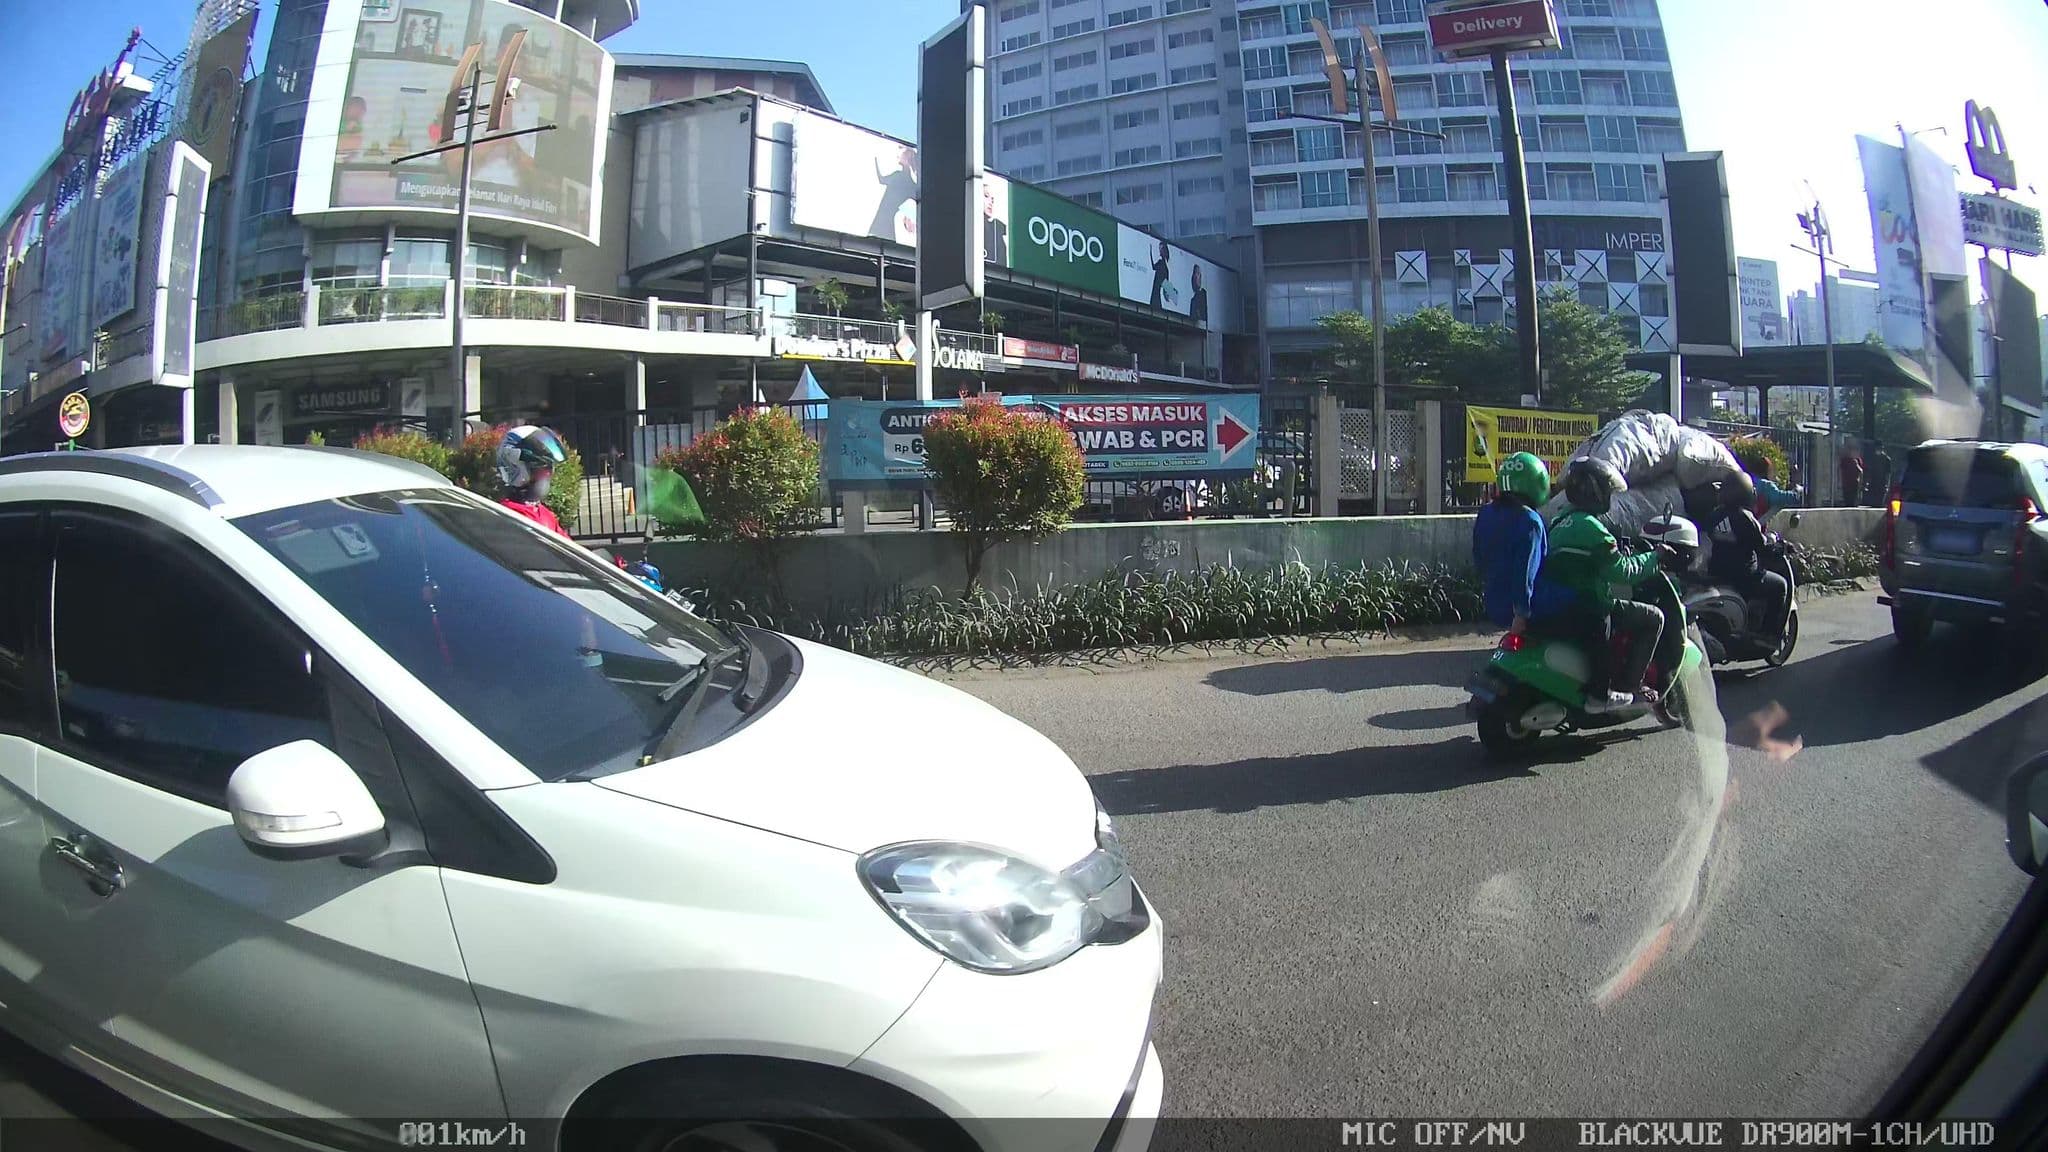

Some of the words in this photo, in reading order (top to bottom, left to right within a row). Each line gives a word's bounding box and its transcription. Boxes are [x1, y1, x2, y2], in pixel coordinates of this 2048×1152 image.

[1453, 15, 1523, 34] Delivery
[469, 188, 495, 201] elamat
[1028, 216, 1104, 263] oppo
[1606, 232, 1663, 250] IMPER
[1086, 363, 1138, 383] McDonald's
[299, 388, 381, 409] SAMSUNG
[1064, 406, 1128, 423] AKSES
[1132, 406, 1204, 422] MASUK
[894, 443, 909, 454] Rp
[1139, 430, 1158, 449] &
[1161, 430, 1205, 448] PCR
